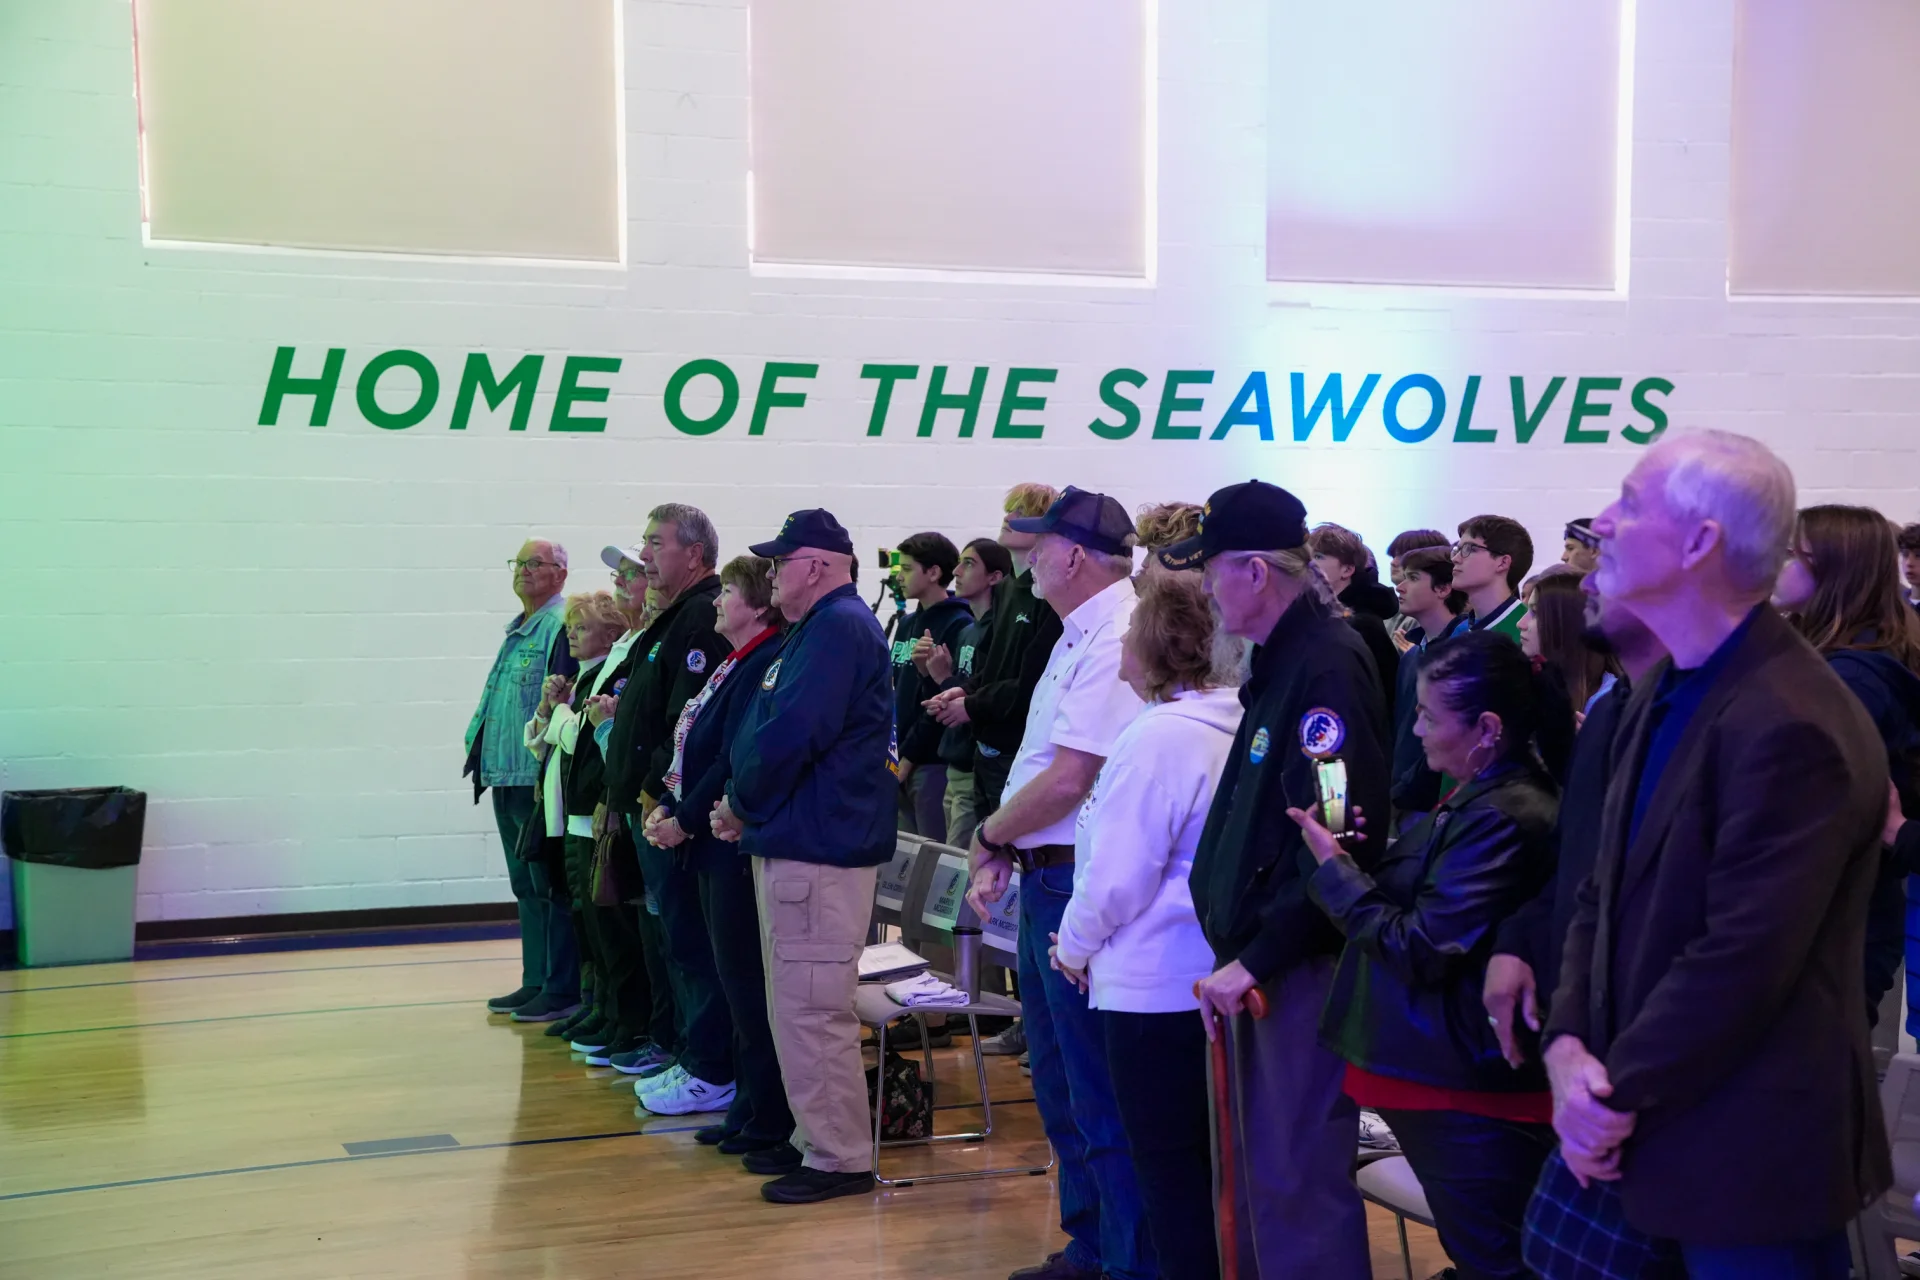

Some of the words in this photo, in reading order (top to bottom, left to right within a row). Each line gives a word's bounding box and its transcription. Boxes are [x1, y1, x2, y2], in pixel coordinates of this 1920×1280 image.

[257, 346, 622, 432] HOME
[663, 358, 819, 435] OF
[860, 363, 1057, 438] THE
[1088, 367, 1675, 445] SEAWOLVES
